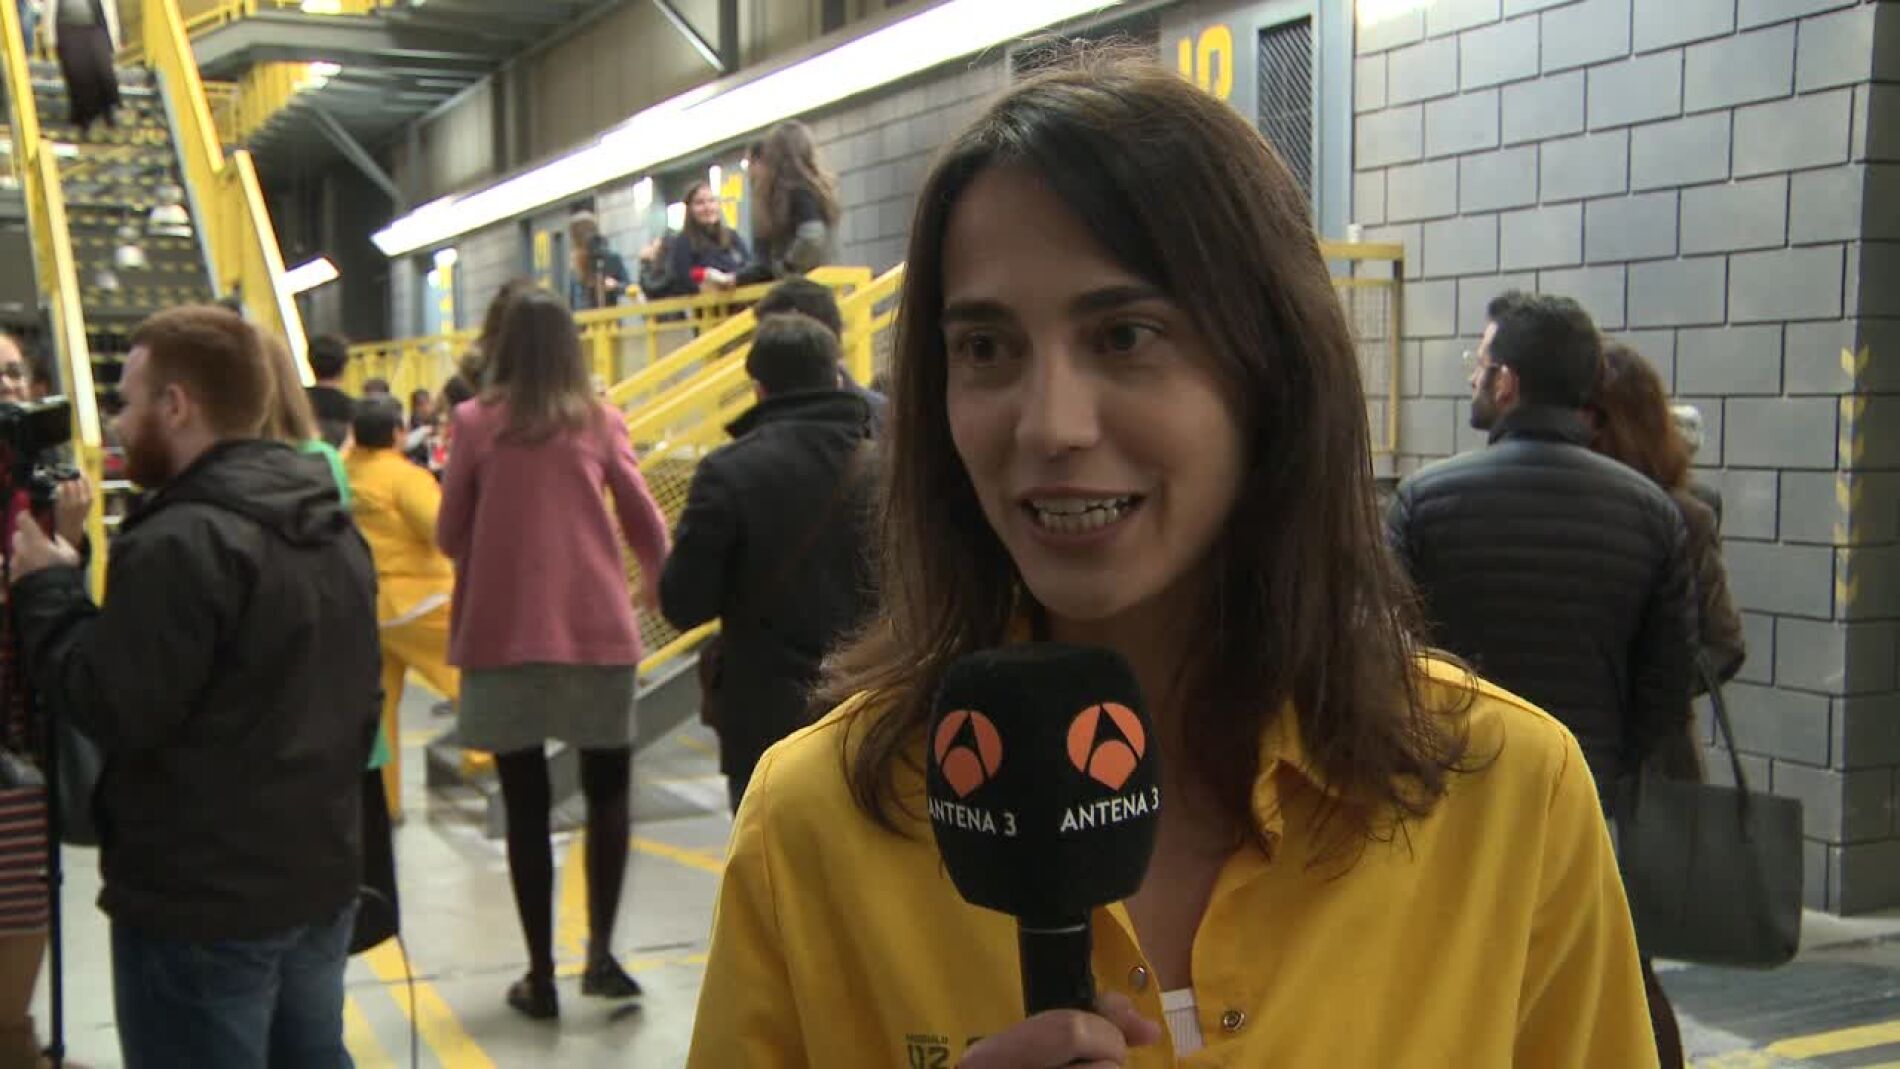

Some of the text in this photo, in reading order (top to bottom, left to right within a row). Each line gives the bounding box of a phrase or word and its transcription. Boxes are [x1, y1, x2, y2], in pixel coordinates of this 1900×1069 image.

[928, 797, 1018, 837] ANTENA 3
[1060, 786, 1160, 832] ANTENA 3
